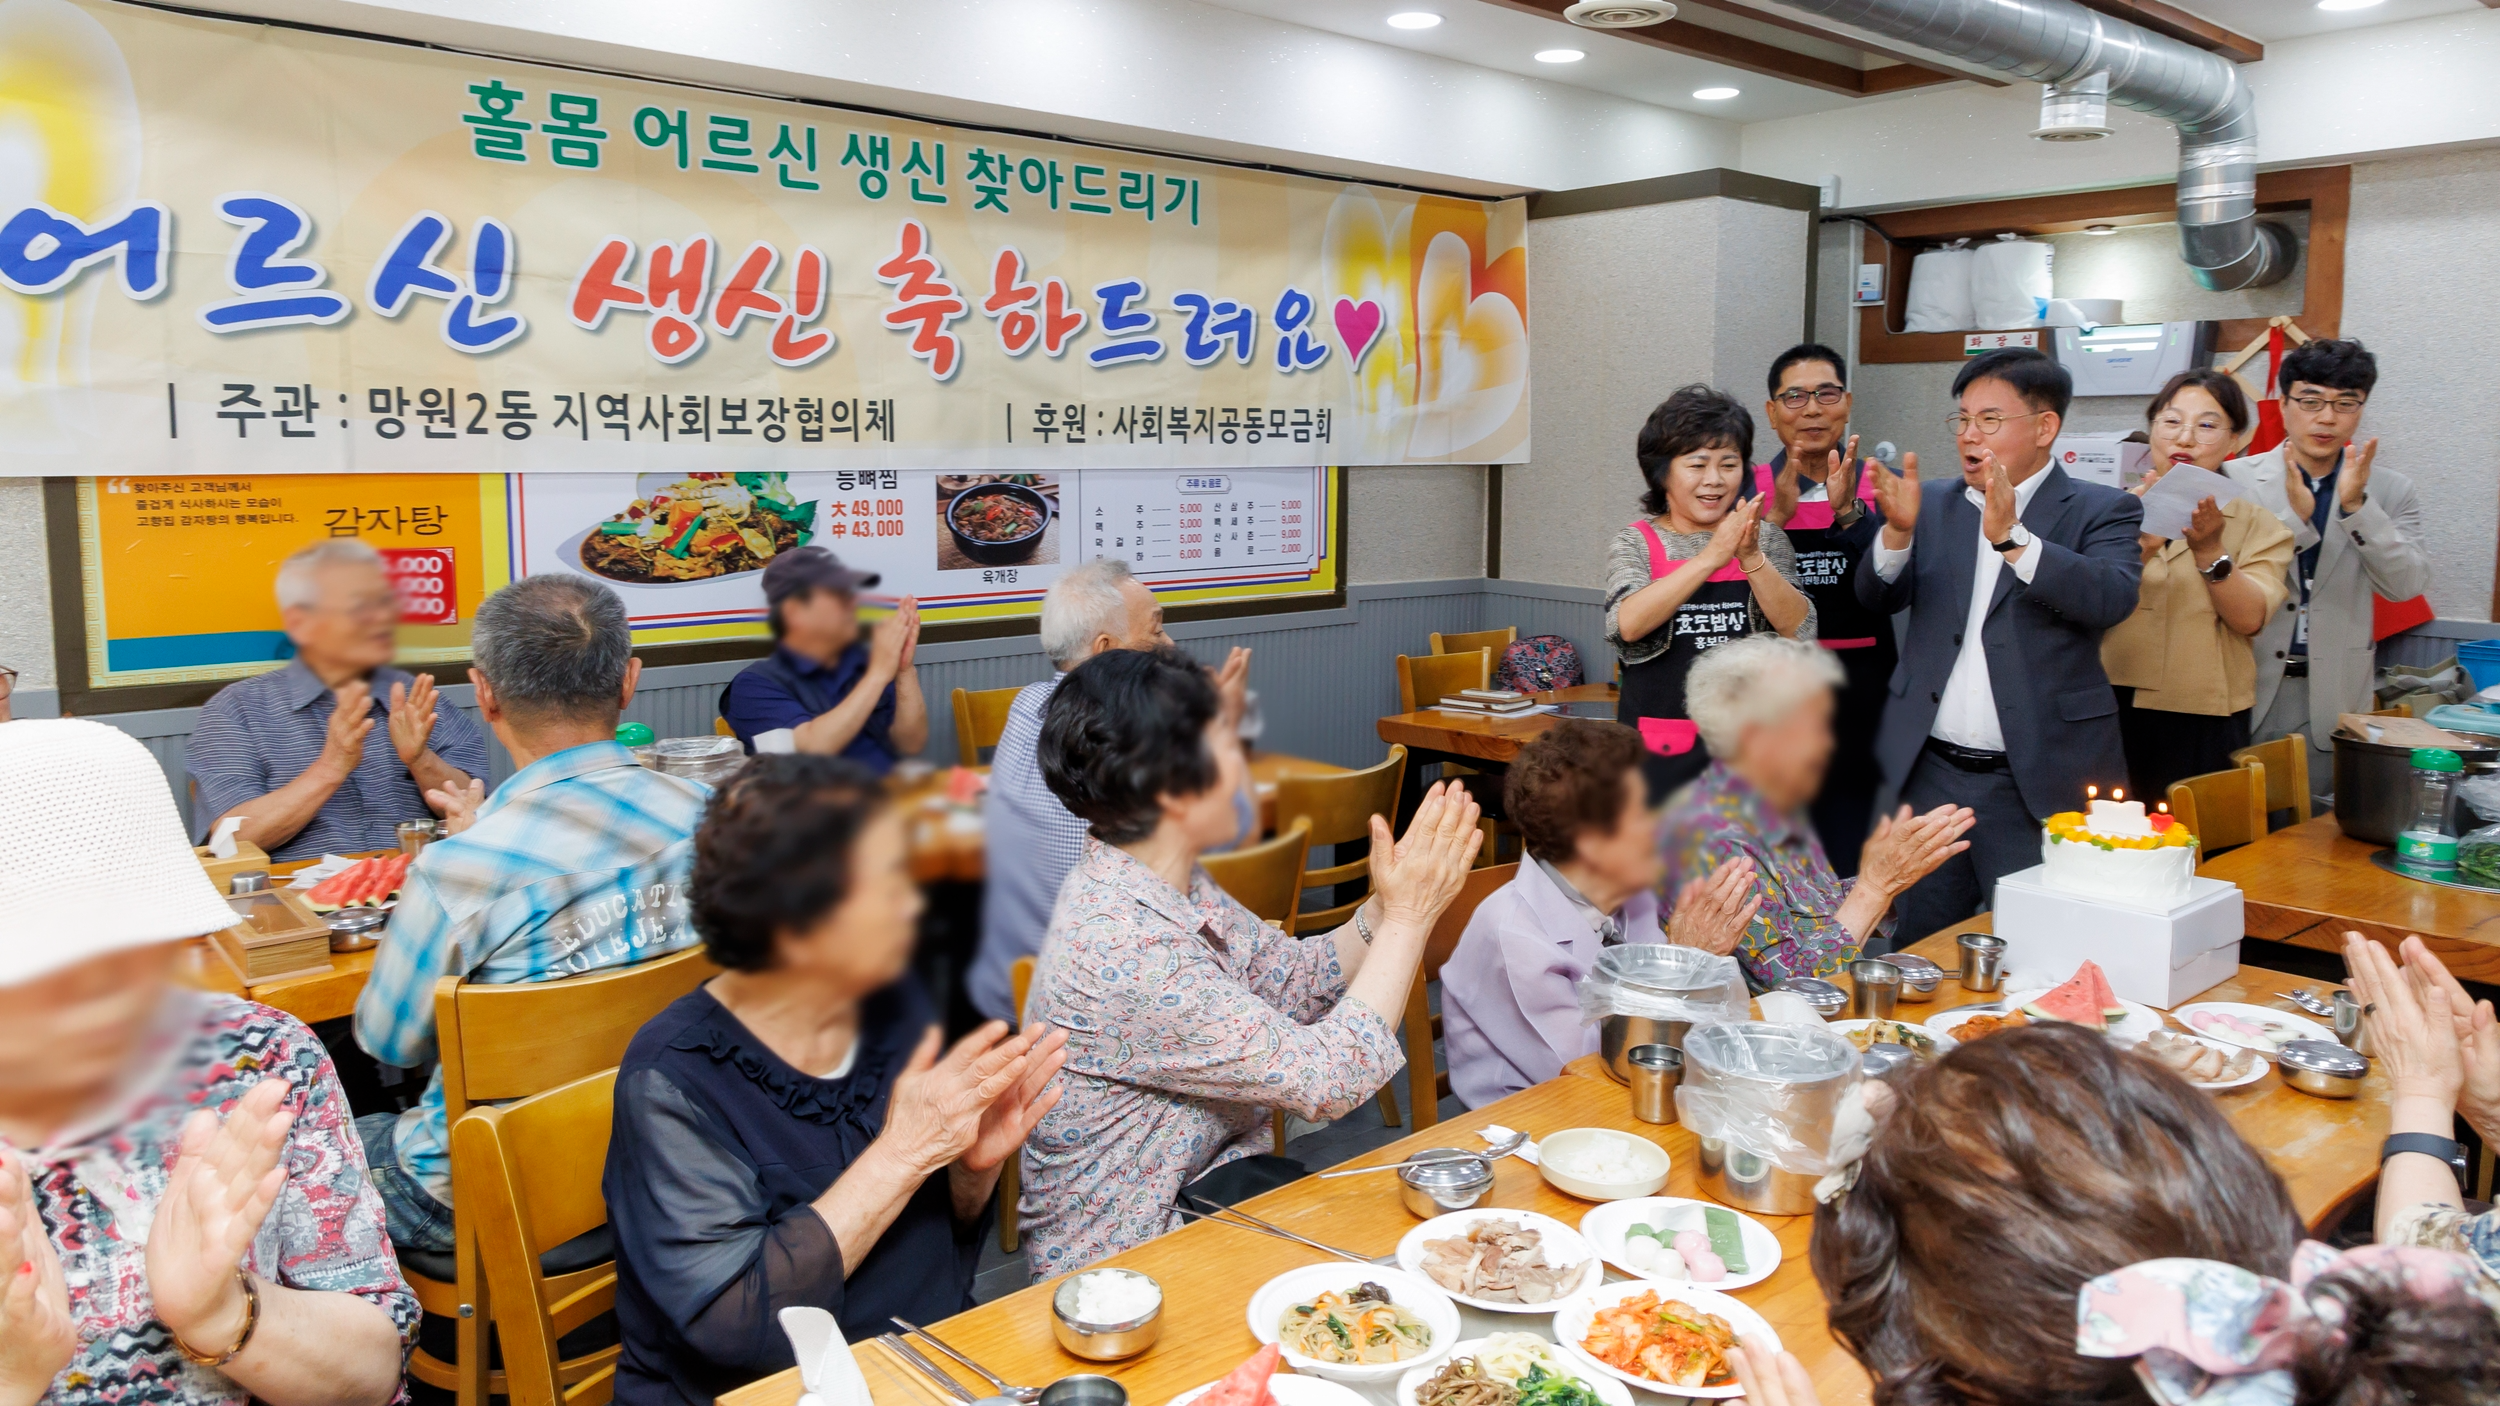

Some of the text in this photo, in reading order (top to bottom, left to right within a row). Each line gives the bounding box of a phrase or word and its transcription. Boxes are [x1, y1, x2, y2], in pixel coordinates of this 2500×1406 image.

[462, 79, 1199, 226] 홀몸 어르신 생신 찾아드리기
[0, 197, 1327, 377] 어르신 생신 축하드려요
[216, 382, 320, 439] 주관
[368, 385, 538, 441] 망원2동
[552, 391, 895, 444] 지역사회보장협의체
[1032, 402, 1086, 443] 후원
[1111, 405, 1332, 444] 사회복지공동모금회
[133, 481, 252, 494] 찾아주신 고객님께서
[136, 497, 282, 510] 즐겁게 식사하시는 모습이
[831, 499, 904, 518] 大 49,000
[1179, 503, 1203, 514] 5,000
[1281, 500, 1302, 510] 5,000
[136, 513, 299, 527] 고향집 감자탕의 행복입니다.
[323, 505, 449, 538] 감자탕
[1179, 518, 1203, 529] 5,000
[1281, 514, 1302, 525] 9,000
[832, 519, 904, 539] 中 43,000
[1281, 529, 1302, 539] 9,000
[1179, 533, 1203, 544] 5,000
[1179, 548, 1203, 559] 6,000
[1281, 543, 1302, 554] 2,000
[982, 569, 1019, 584] 육개장
[1674, 611, 1747, 636] 효도밥상
[555, 883, 690, 953] EDUCATI
